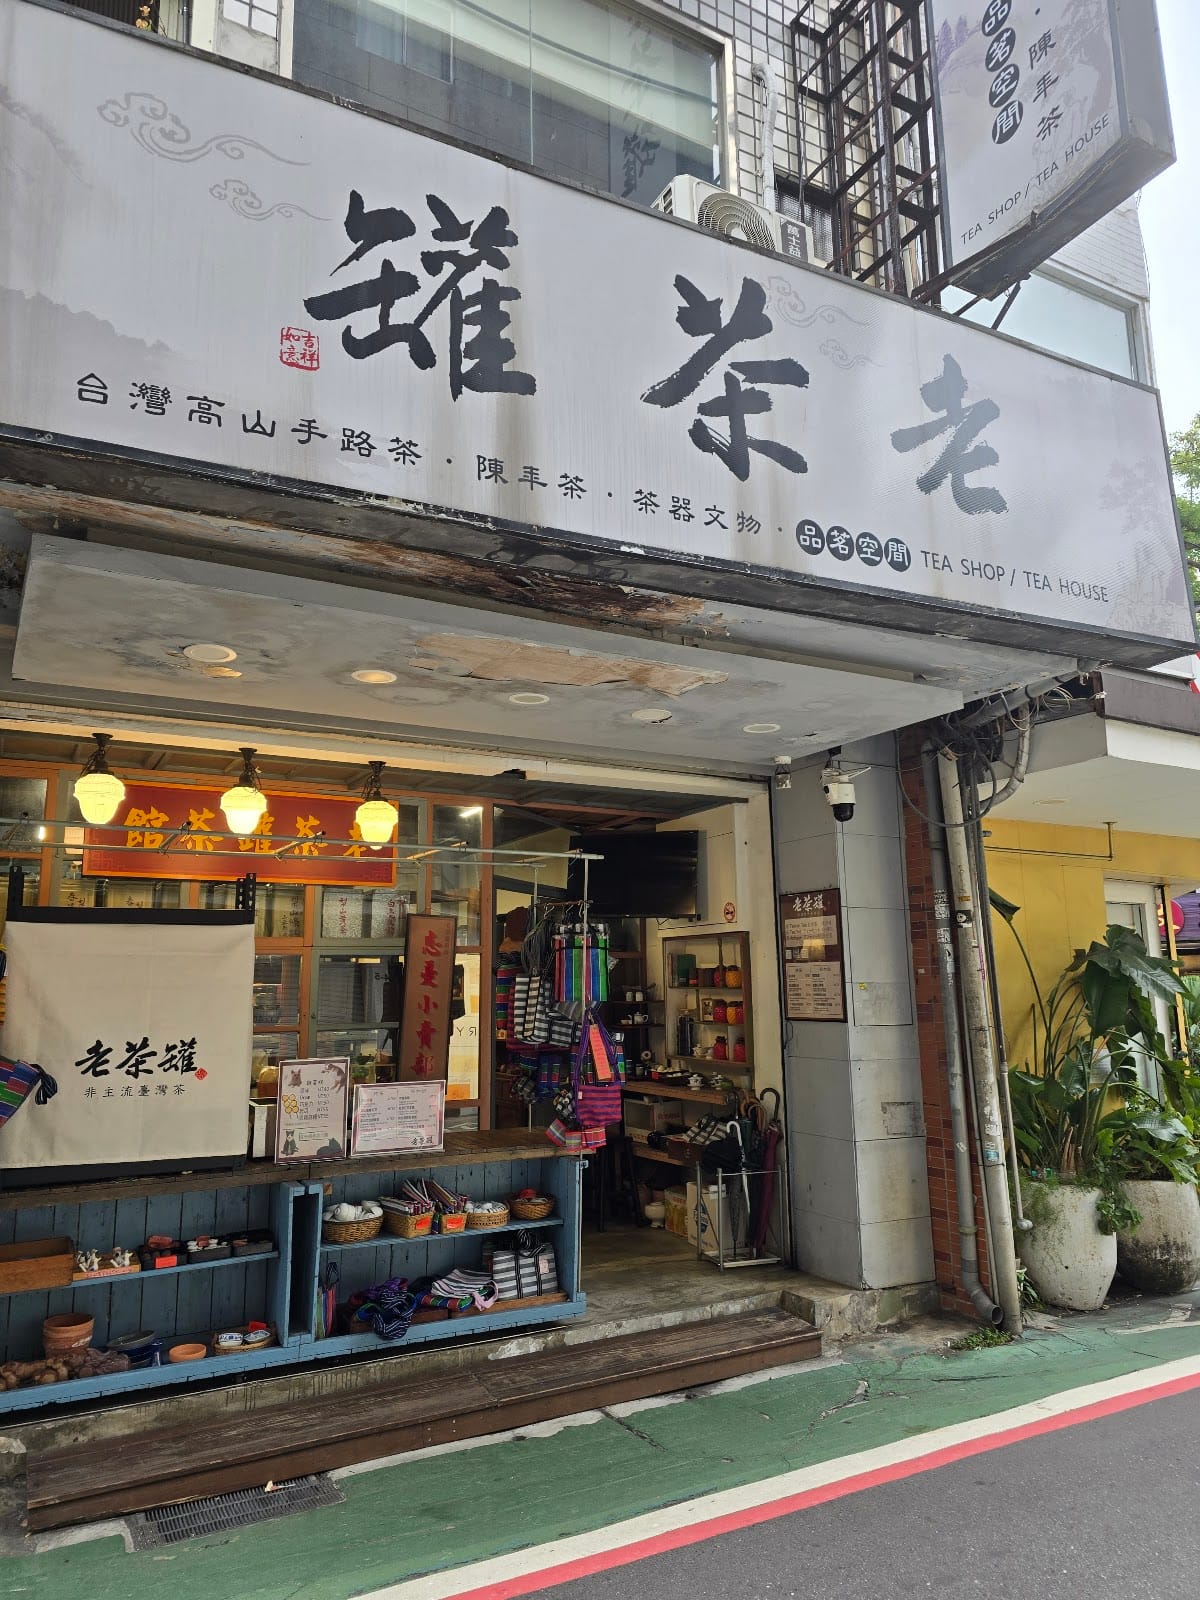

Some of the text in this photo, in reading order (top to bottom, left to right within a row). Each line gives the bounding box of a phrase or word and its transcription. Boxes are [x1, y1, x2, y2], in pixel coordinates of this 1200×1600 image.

[982, 0, 1023, 144] 品茗空間
[961, 223, 983, 245] TEA
[988, 191, 1021, 225] SHOP
[1035, 161, 1059, 186] TEA
[1065, 113, 1110, 162] HOUSE
[76, 372, 423, 467] 台灣高山手路茶
[633, 488, 762, 536] 茶器文物
[796, 519, 911, 572] 品茗空間
[920, 550, 953, 573] TEA
[961, 558, 1005, 582] SHOP
[1023, 570, 1052, 592] TEA
[1059, 577, 1109, 603] HOUSE
[793, 894, 824, 912] 老茶罐
[75, 1036, 198, 1079] 老茶罐
[84, 1084, 186, 1099] 非主流臺灣茶
